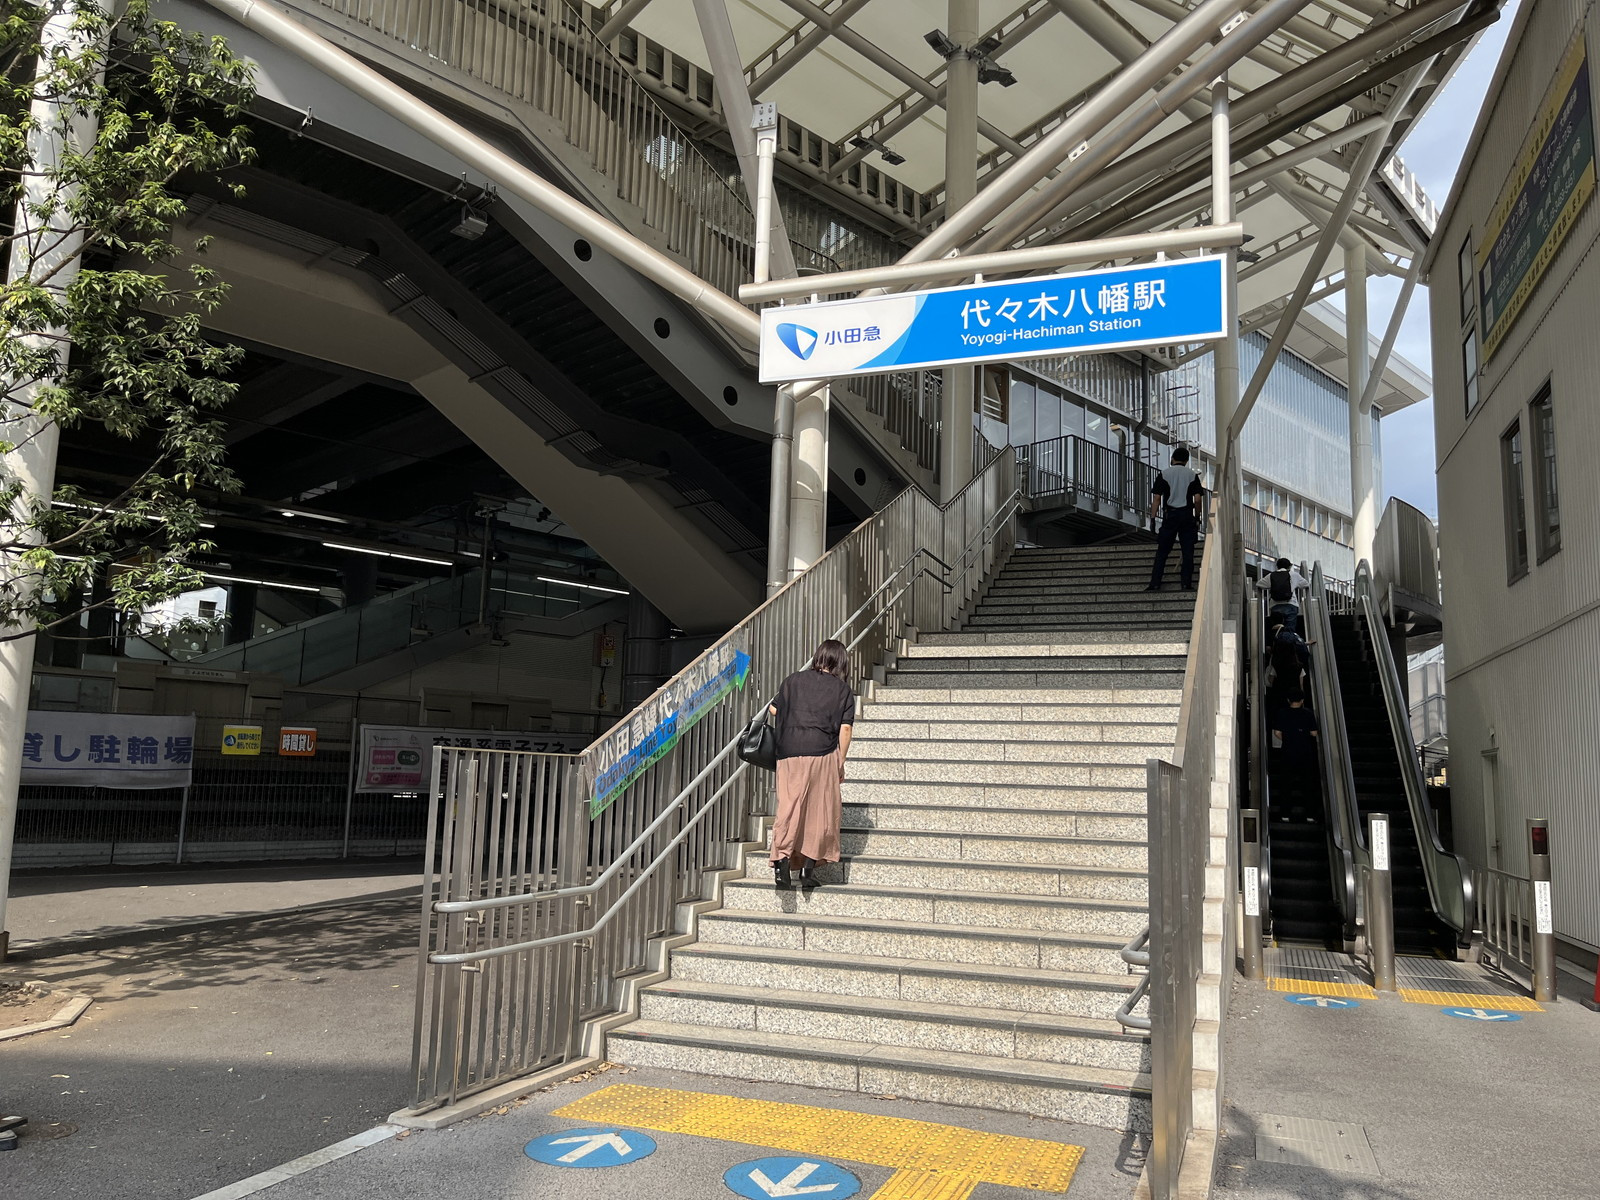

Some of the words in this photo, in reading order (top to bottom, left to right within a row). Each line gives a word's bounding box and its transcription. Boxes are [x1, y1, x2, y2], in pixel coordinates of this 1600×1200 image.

[824, 326, 882, 347] 小田急
[960, 278, 1167, 330] 代々木八幡駅
[960, 323, 1085, 347] Yoyogi-Hachiman
[1088, 317, 1142, 332] Station
[282, 733, 314, 752] 時間貸し
[597, 755, 637, 795] Odakyu
[639, 735, 658, 758] Line
